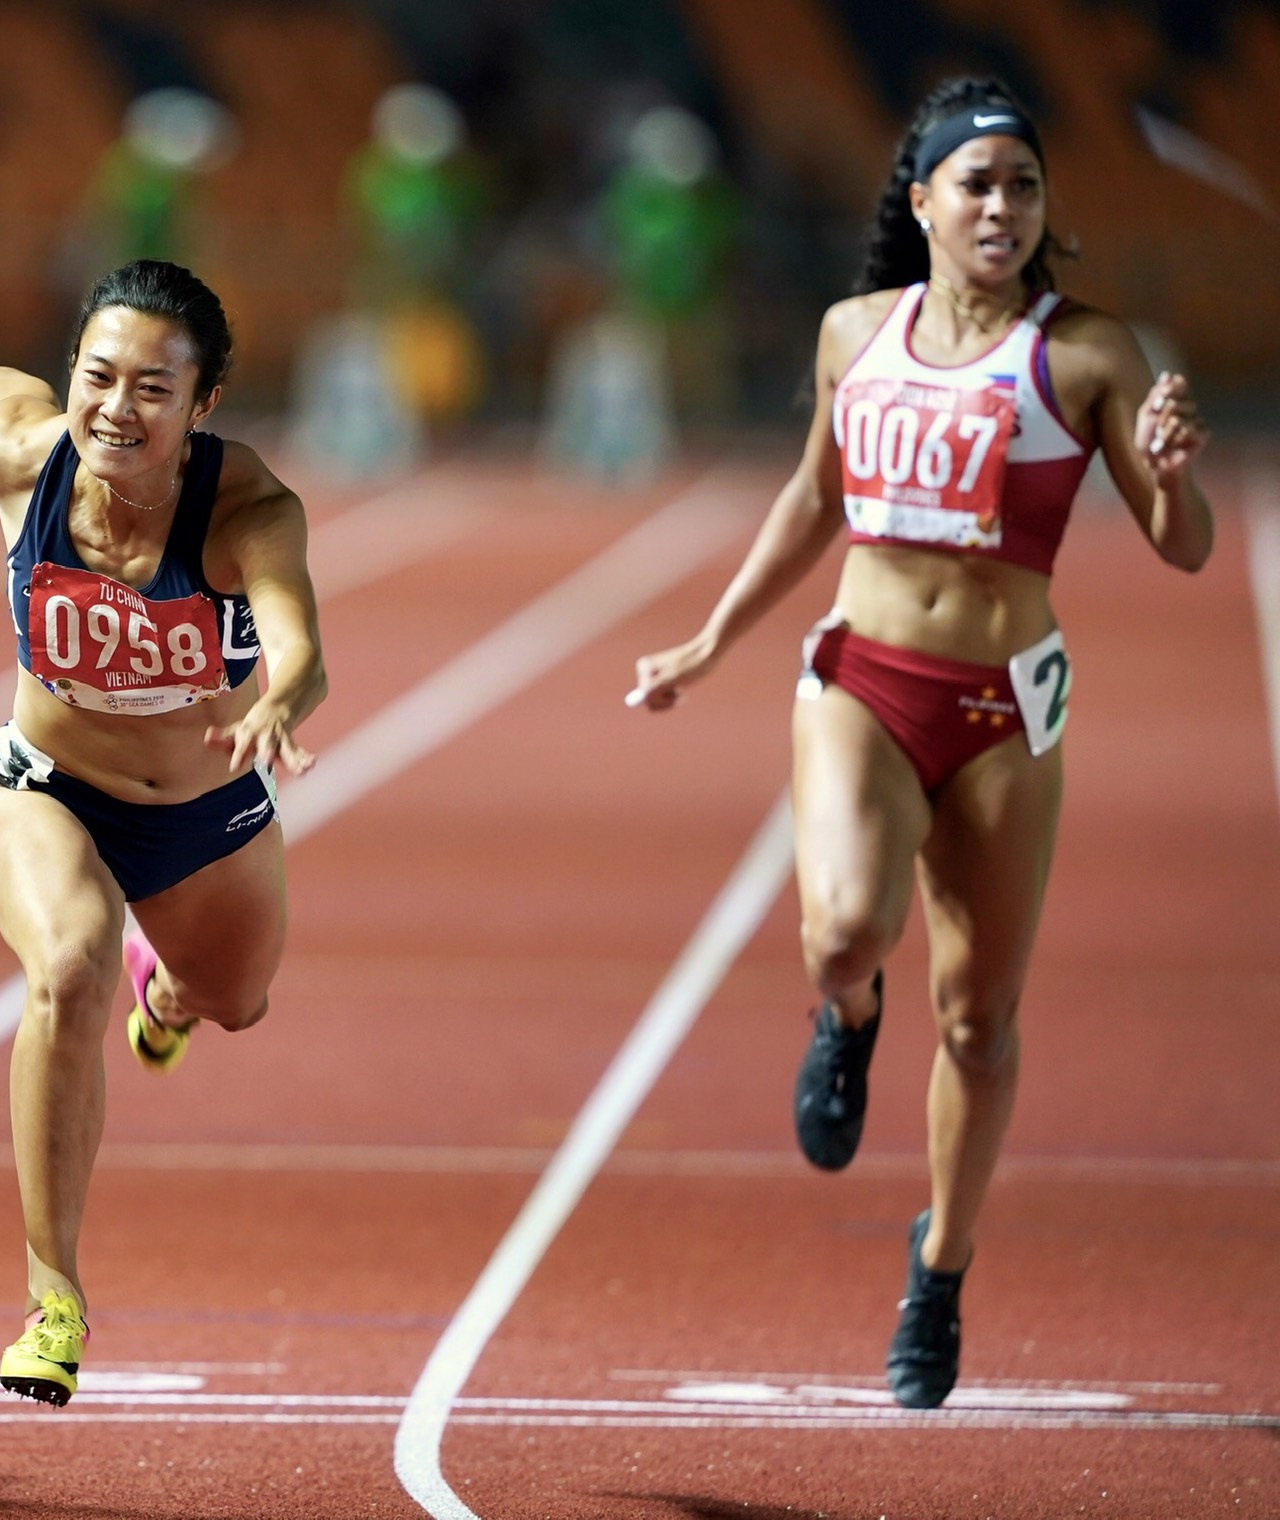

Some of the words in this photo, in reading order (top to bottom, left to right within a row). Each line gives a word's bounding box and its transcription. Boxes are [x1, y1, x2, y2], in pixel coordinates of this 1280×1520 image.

[847, 401, 998, 493] 0067
[100, 582, 114, 601] TU
[45, 595, 207, 677] 0958
[105, 671, 152, 688] VIETNAM
